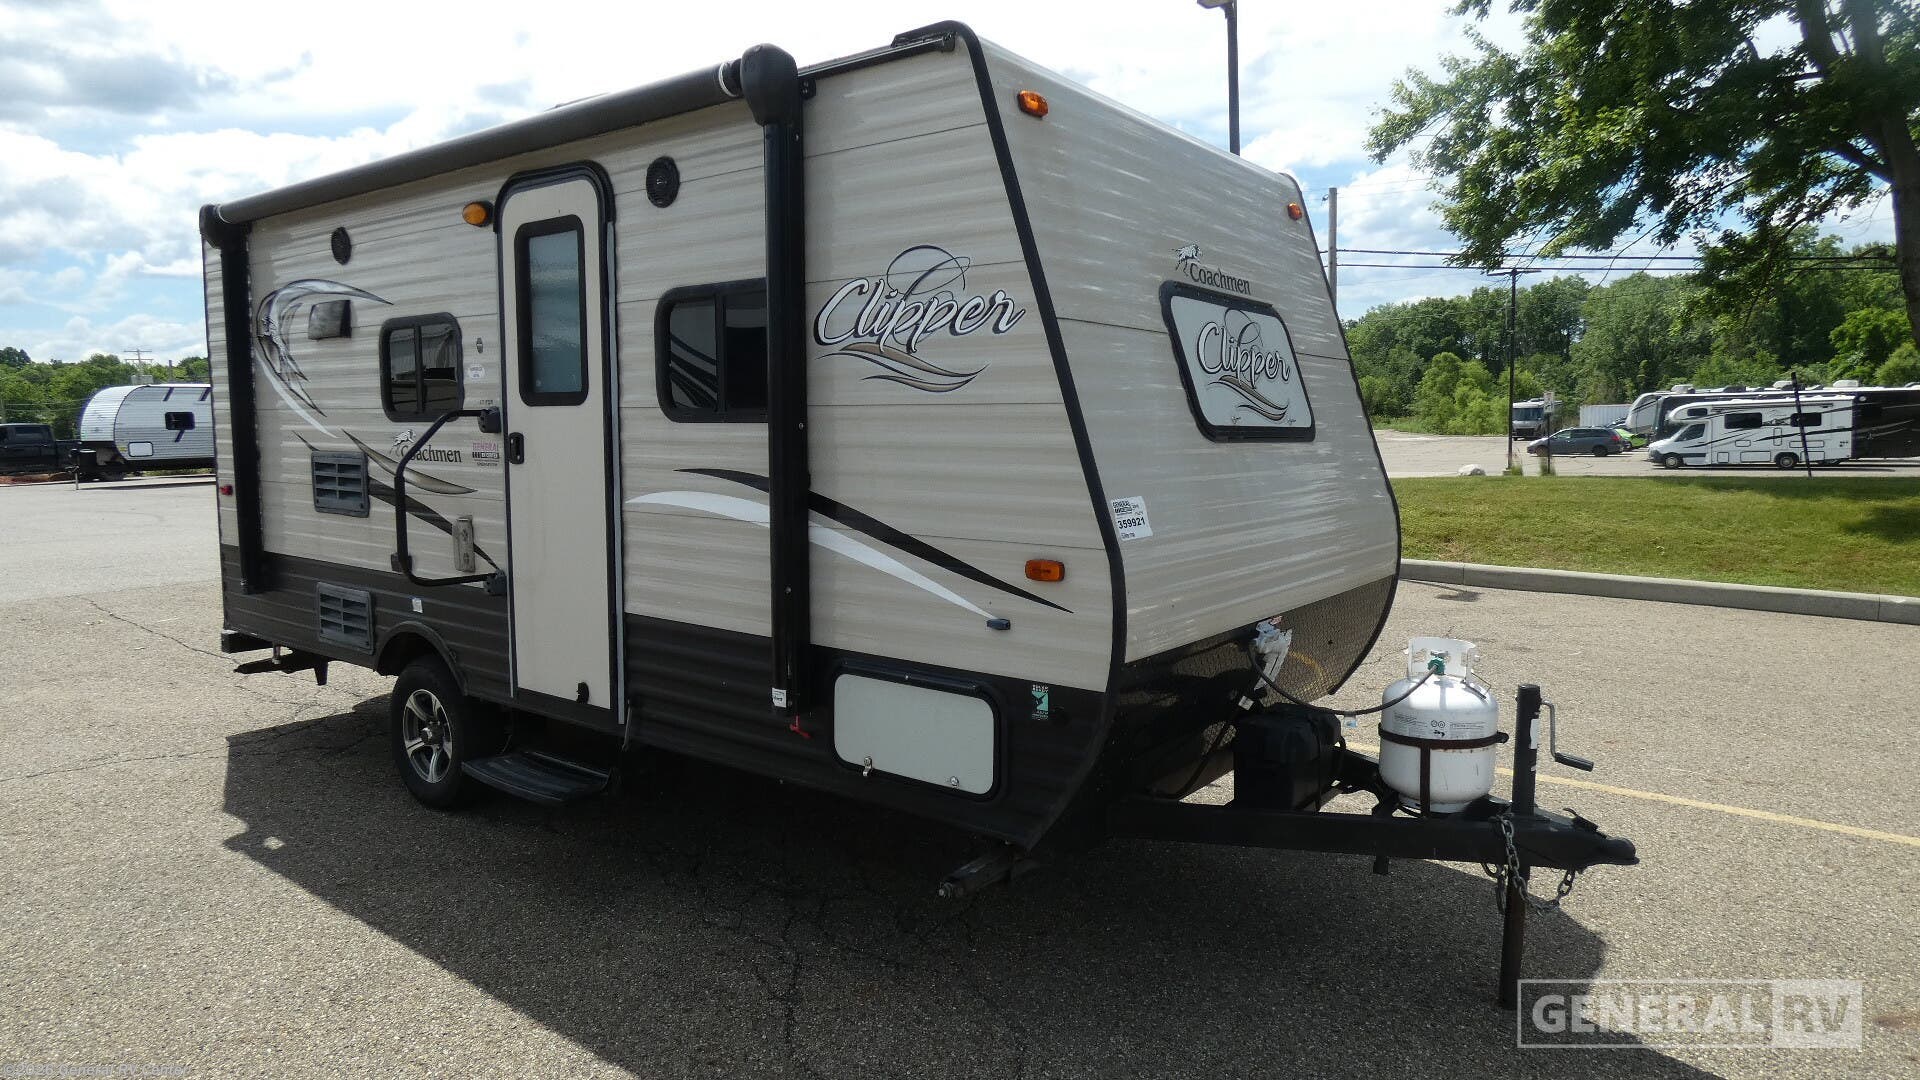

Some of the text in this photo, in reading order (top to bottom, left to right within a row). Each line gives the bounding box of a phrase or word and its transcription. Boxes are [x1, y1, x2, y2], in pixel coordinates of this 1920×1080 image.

[1189, 262, 1251, 295] Coachmen
[814, 277, 1027, 354] Clipper
[1196, 321, 1291, 390] Clipper
[400, 444, 463, 463] Cachmen
[1117, 516, 1146, 530] 359921
